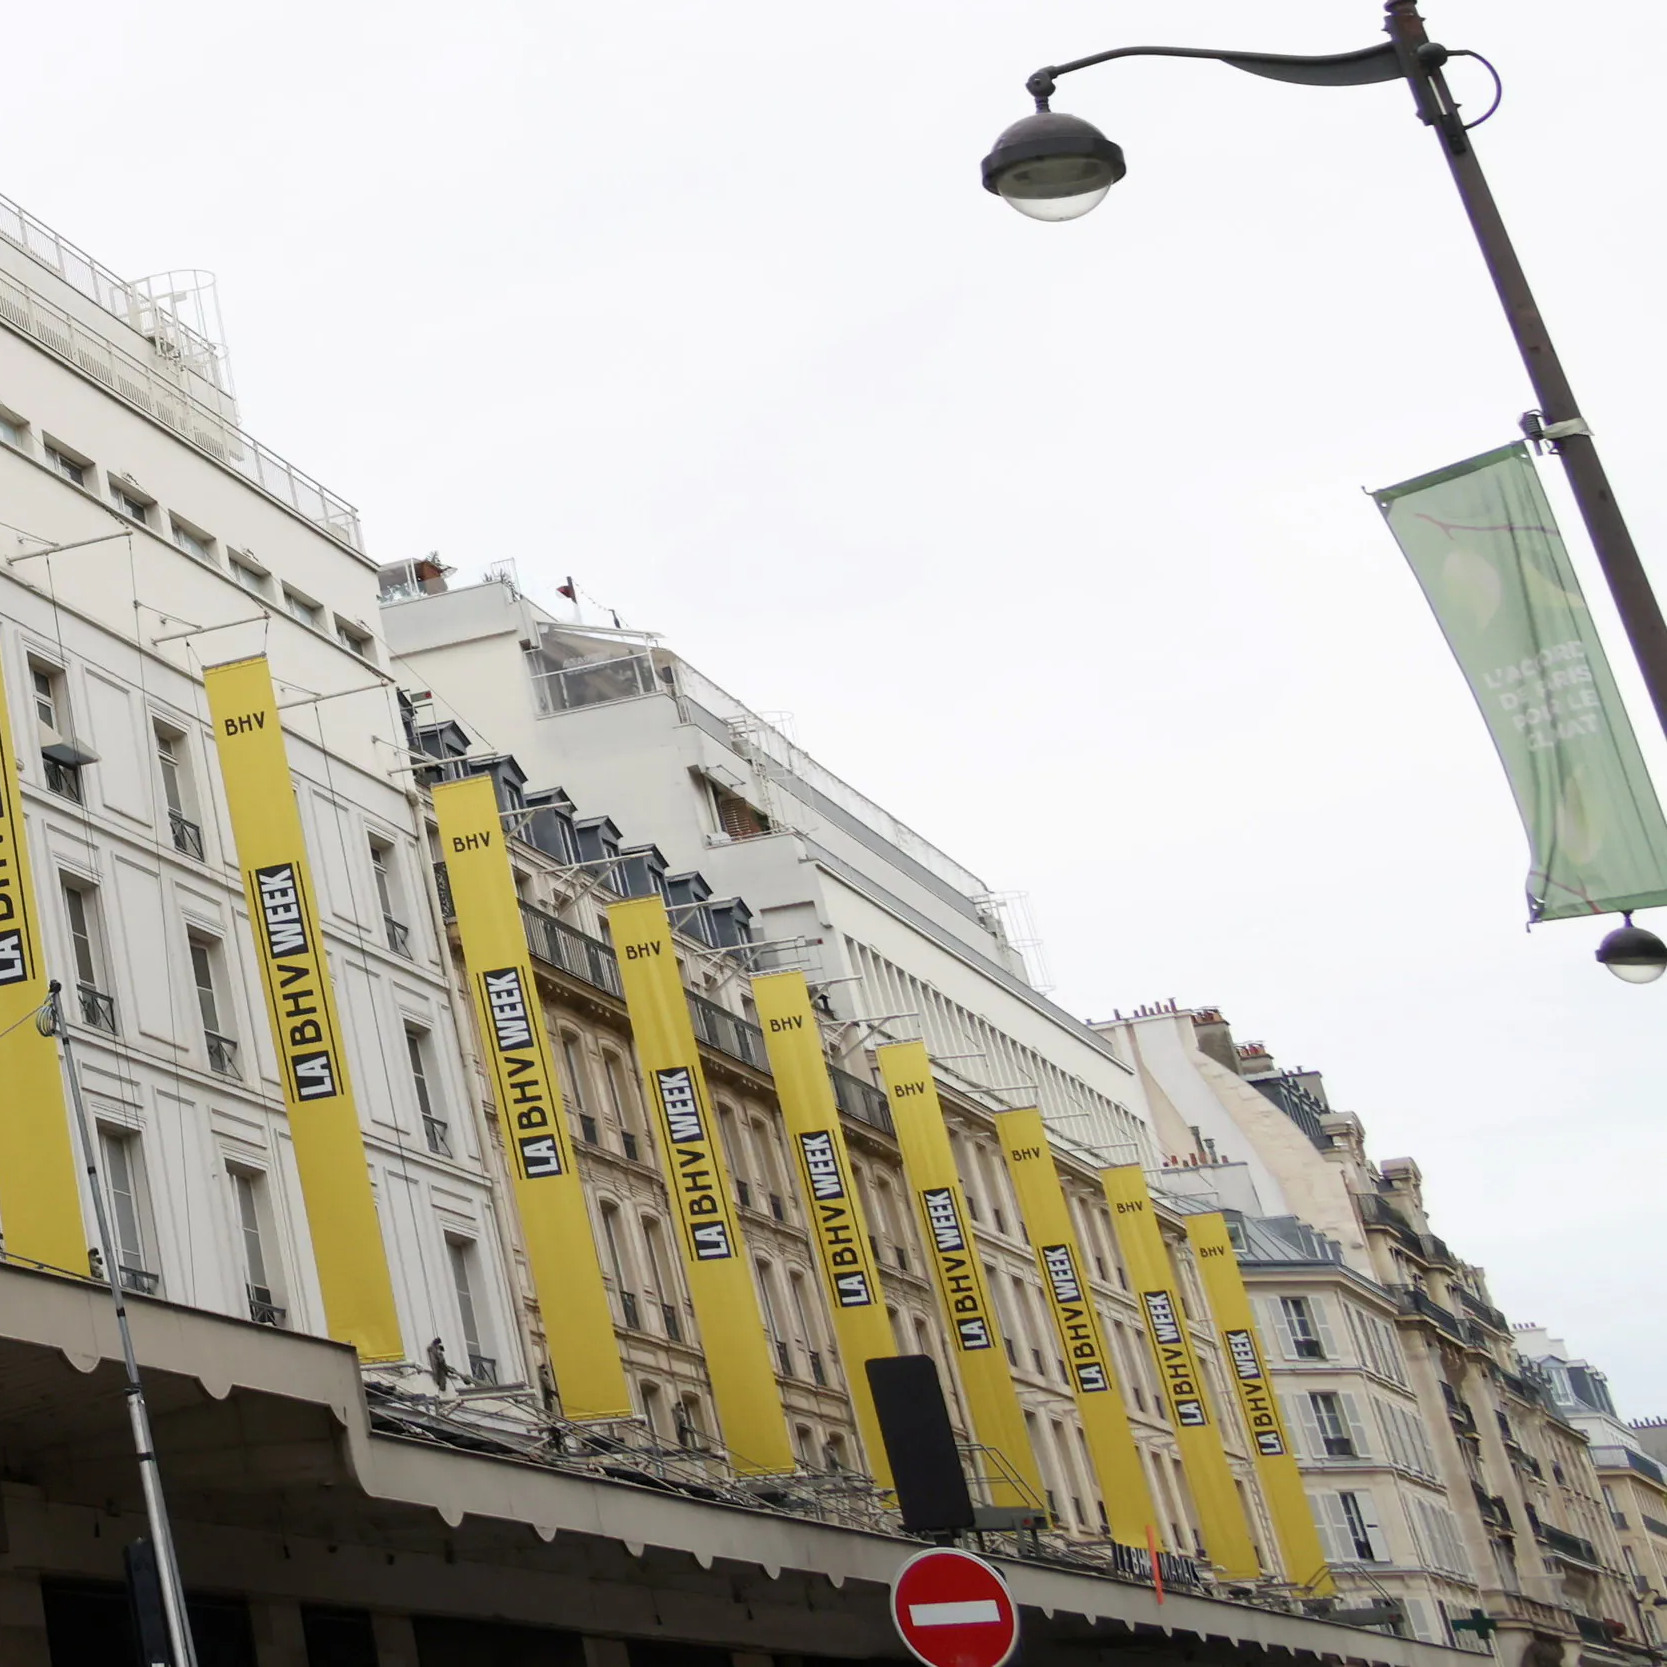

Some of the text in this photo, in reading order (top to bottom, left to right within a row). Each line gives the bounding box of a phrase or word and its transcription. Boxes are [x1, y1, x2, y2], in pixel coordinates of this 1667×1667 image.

[1568, 689, 1600, 710] LE
[224, 711, 265, 736] BHV
[453, 832, 490, 852] BHV
[625, 941, 661, 960] BHV
[259, 868, 334, 1096] LA BHV WEEK
[770, 1015, 802, 1032] BHV
[486, 971, 559, 1175] LA BHV WEEK
[895, 1082, 925, 1097] BHV
[659, 1071, 729, 1257] LA BHV WEEK
[1012, 1147, 1040, 1162] BHV
[802, 1134, 868, 1305] LA BHV WEEK
[1117, 1201, 1143, 1214] BHV
[1200, 1246, 1225, 1258] BHV
[925, 1191, 988, 1348] LA BHV WEEK
[1044, 1247, 1104, 1390] LA BHV WEEK
[1146, 1294, 1202, 1424] LA BHV WEEK
[1228, 1332, 1283, 1453] LA BHV WEEK
